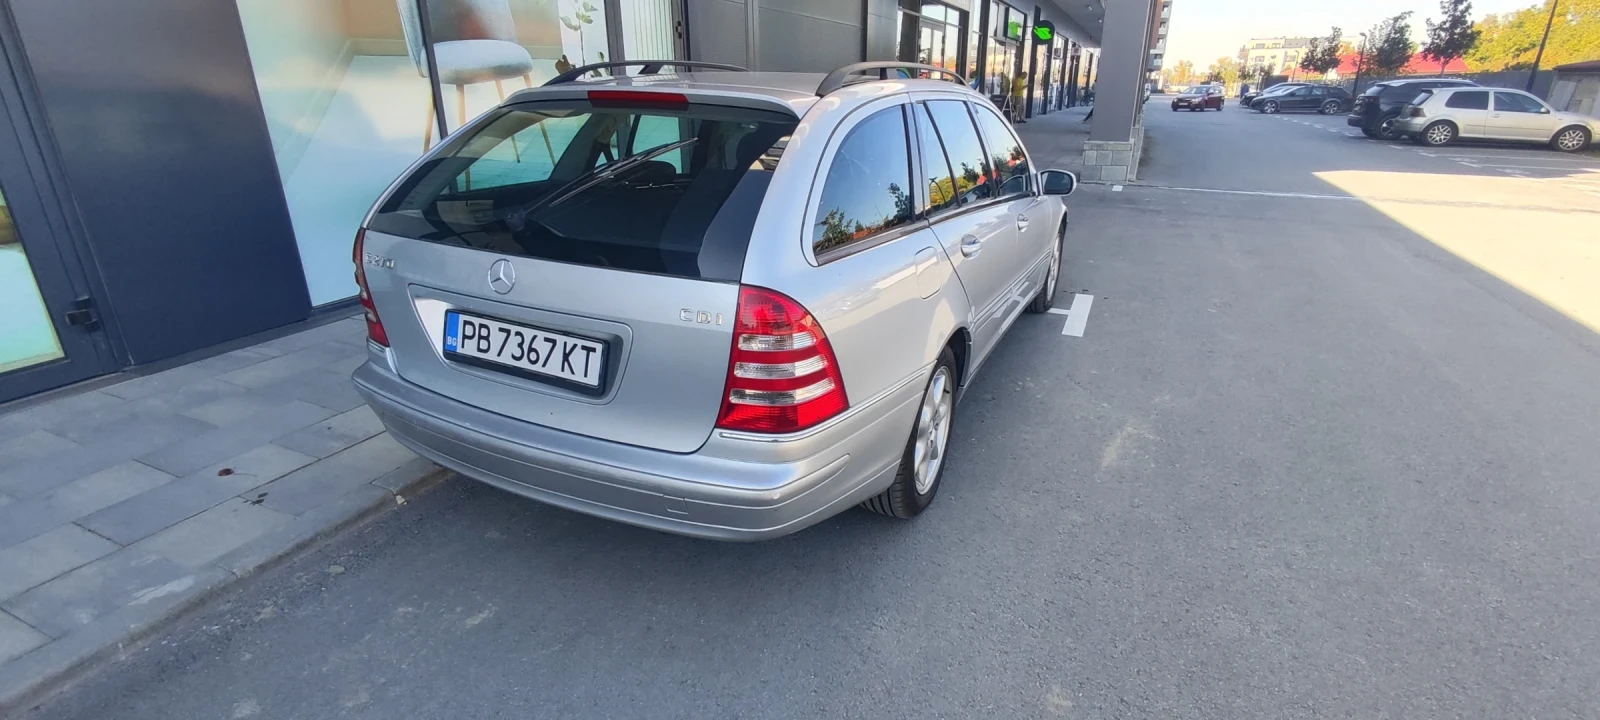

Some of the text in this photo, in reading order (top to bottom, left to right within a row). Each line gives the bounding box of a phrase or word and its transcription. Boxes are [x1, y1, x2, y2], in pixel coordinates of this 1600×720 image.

[679, 308, 723, 326] CDI
[447, 335, 457, 347] BG
[461, 319, 597, 378] PB 7367 KT
